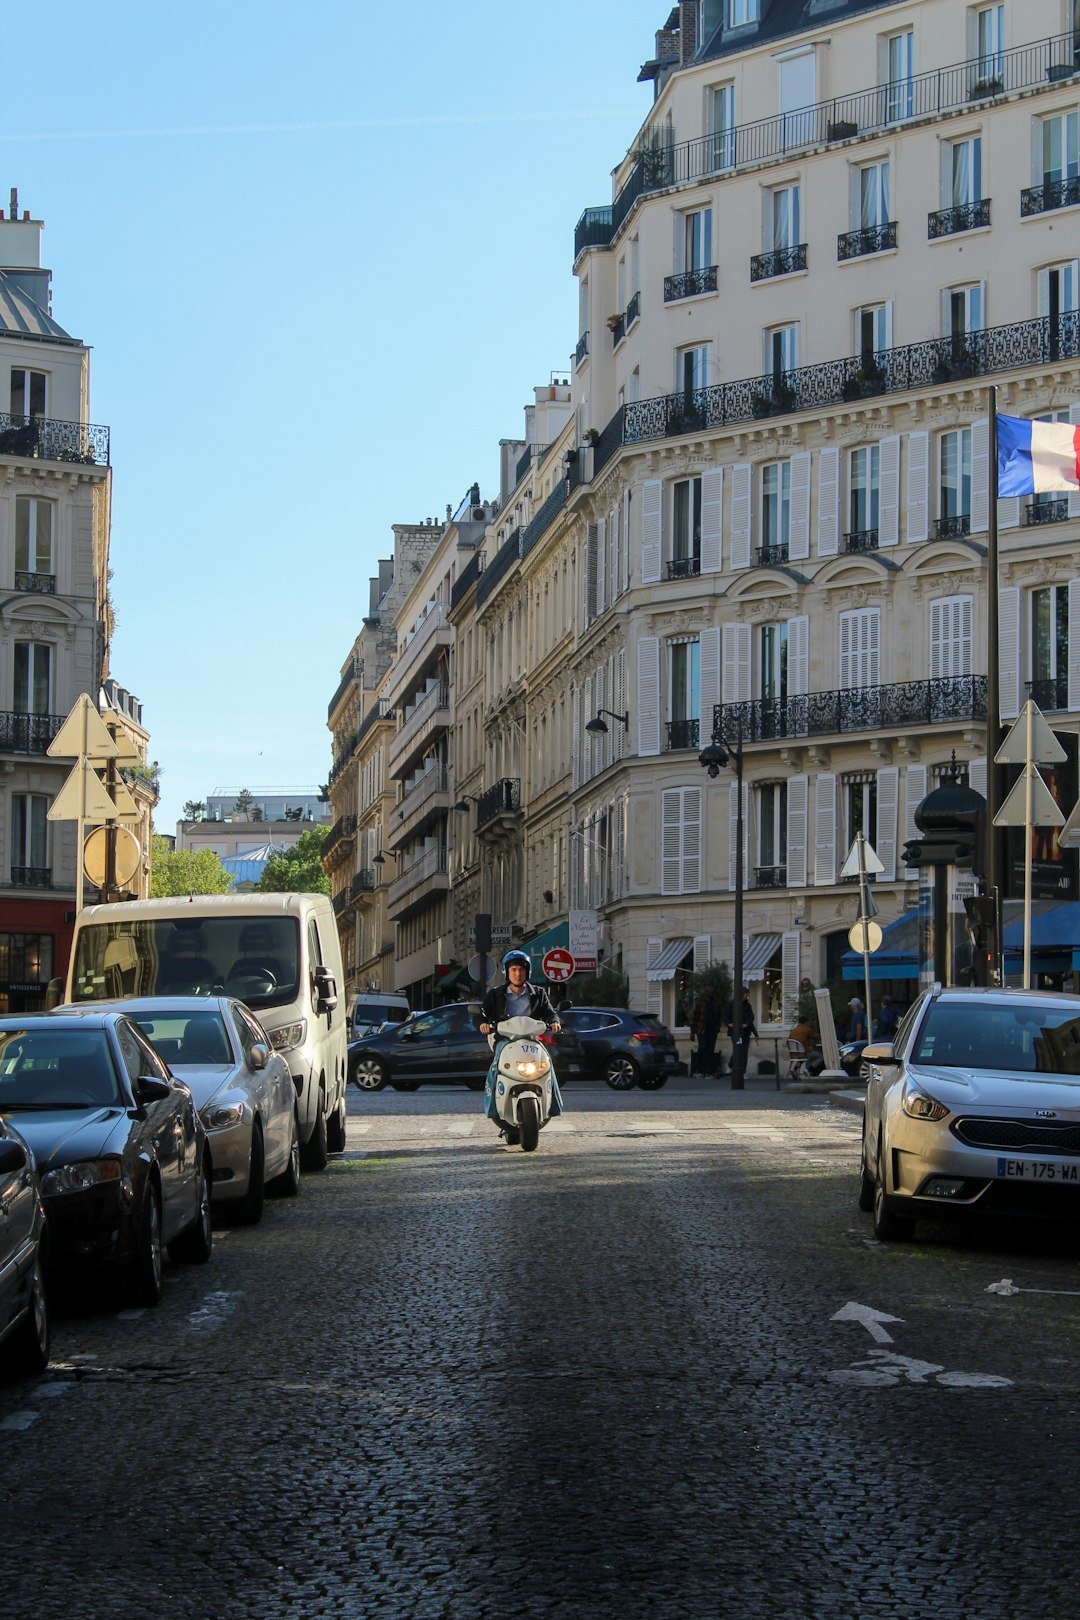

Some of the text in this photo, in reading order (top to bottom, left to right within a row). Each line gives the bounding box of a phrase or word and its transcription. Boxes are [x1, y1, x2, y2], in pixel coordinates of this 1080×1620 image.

[469, 926, 510, 934] TRERIE
[469, 937, 511, 945] BSSERIE
[571, 938, 595, 946] Champs
